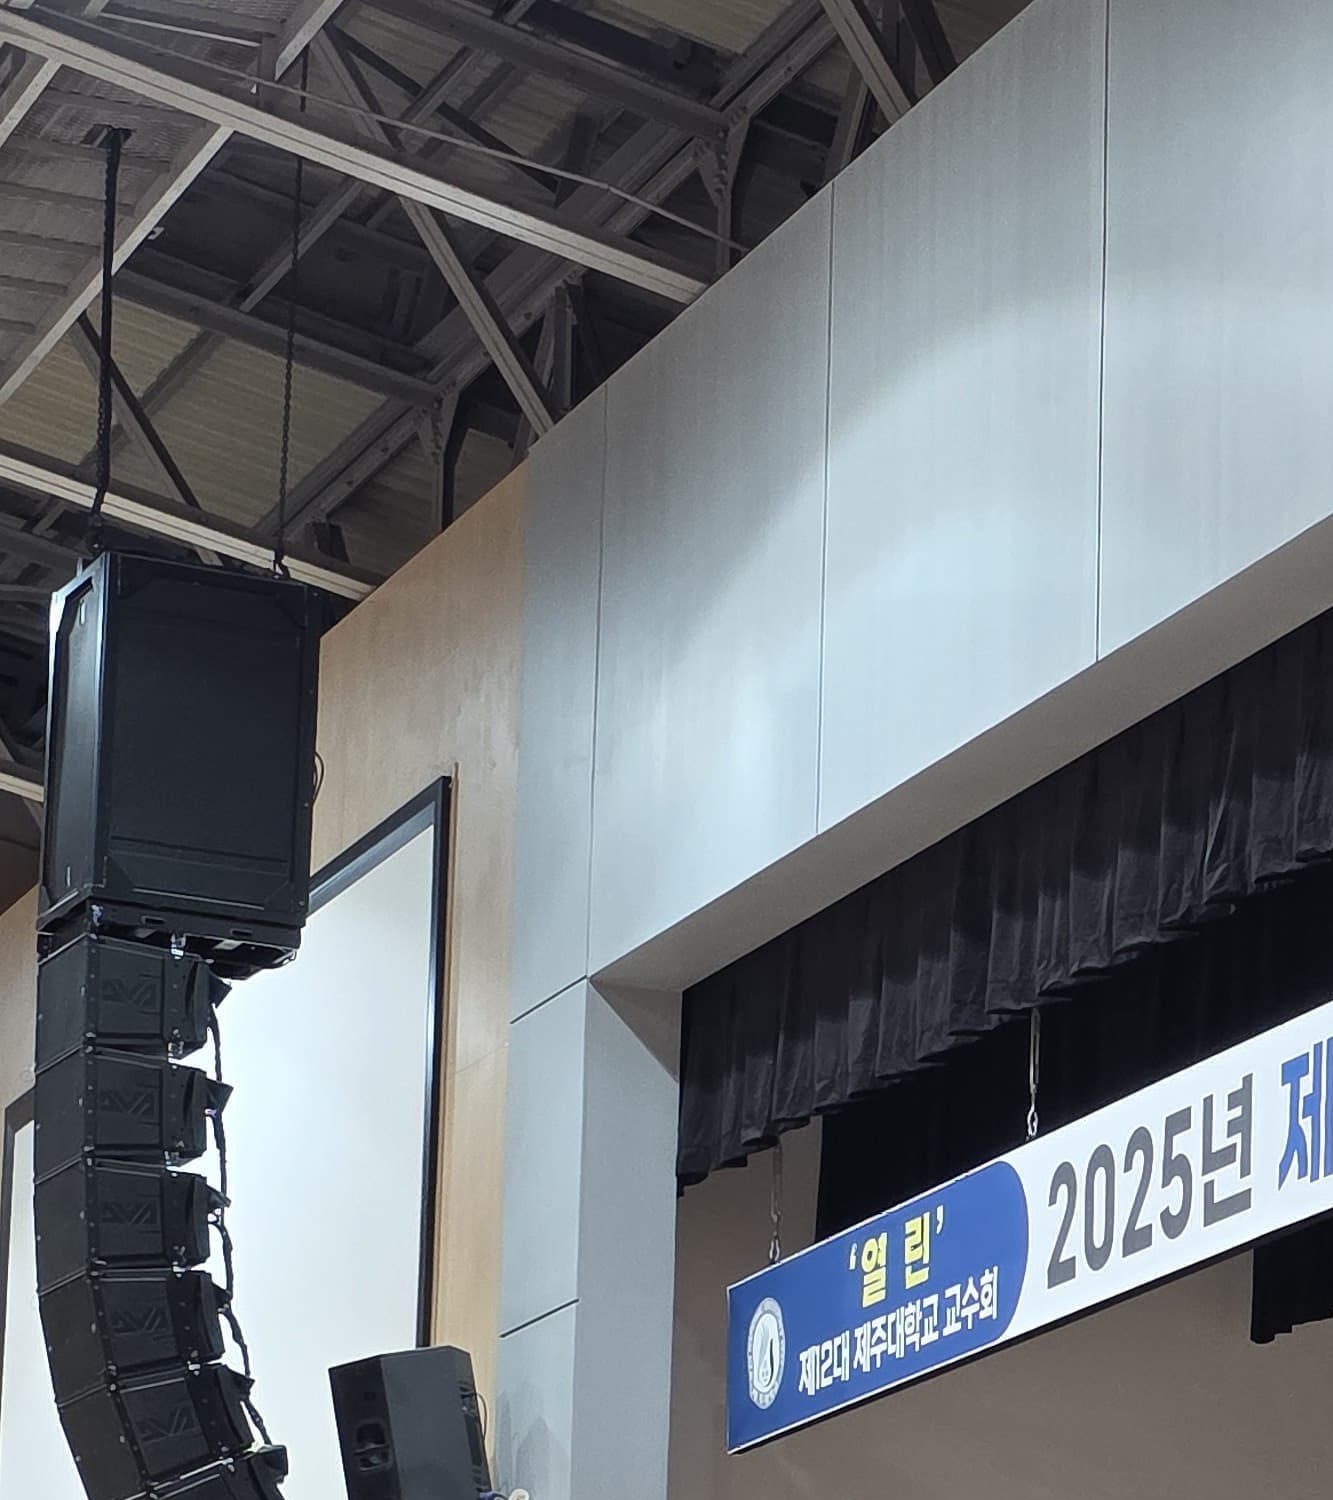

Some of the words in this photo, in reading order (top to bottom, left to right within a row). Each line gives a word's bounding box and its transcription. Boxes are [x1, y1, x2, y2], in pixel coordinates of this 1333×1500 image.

[1047, 1072, 1253, 1290] 2025년
[798, 1329, 850, 1396] 제12대
[853, 1294, 939, 1373] 제주대학교
[942, 1265, 999, 1337] 교수회
